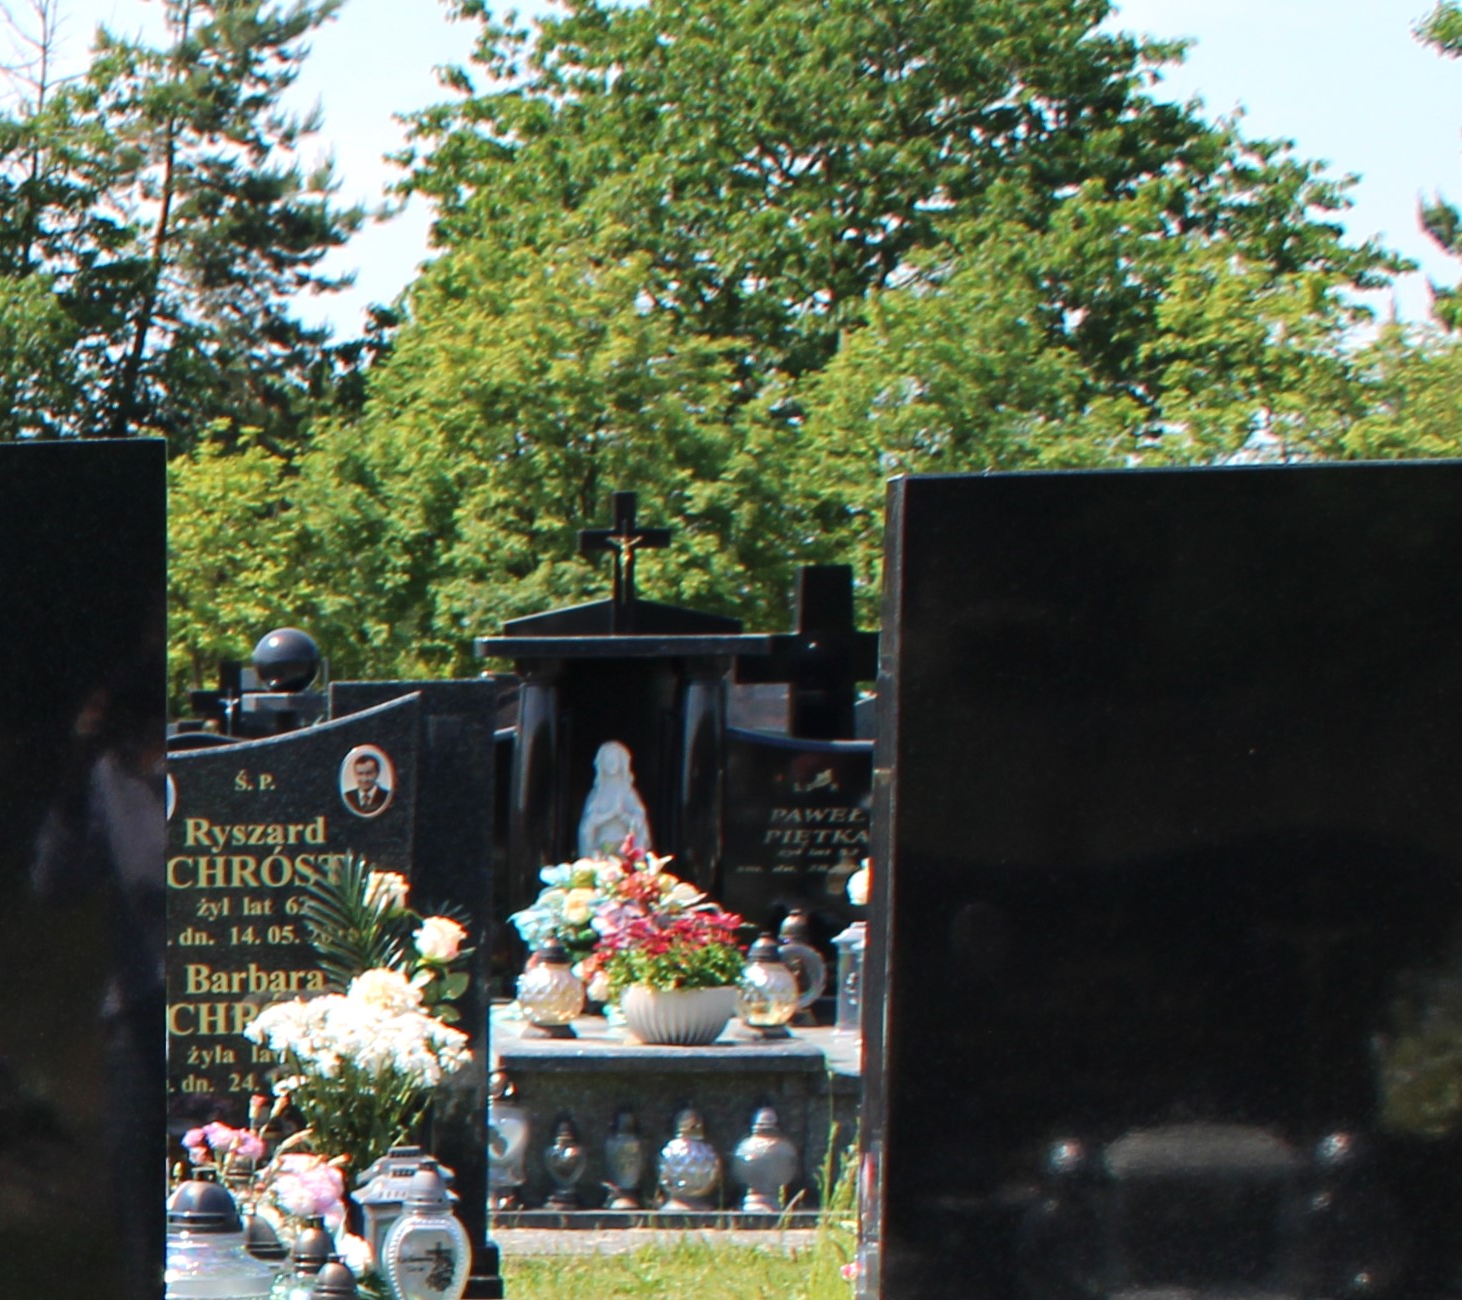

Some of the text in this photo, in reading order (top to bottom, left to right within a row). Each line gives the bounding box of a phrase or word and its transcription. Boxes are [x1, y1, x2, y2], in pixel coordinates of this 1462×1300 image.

[184, 816, 327, 854] Ryszard
[242, 896, 273, 917] lat
[178, 926, 215, 947] dn.
[230, 925, 261, 946] 14.
[266, 924, 300, 946] 05.
[184, 962, 326, 995] Barbara
[182, 1073, 215, 1093] dn.
